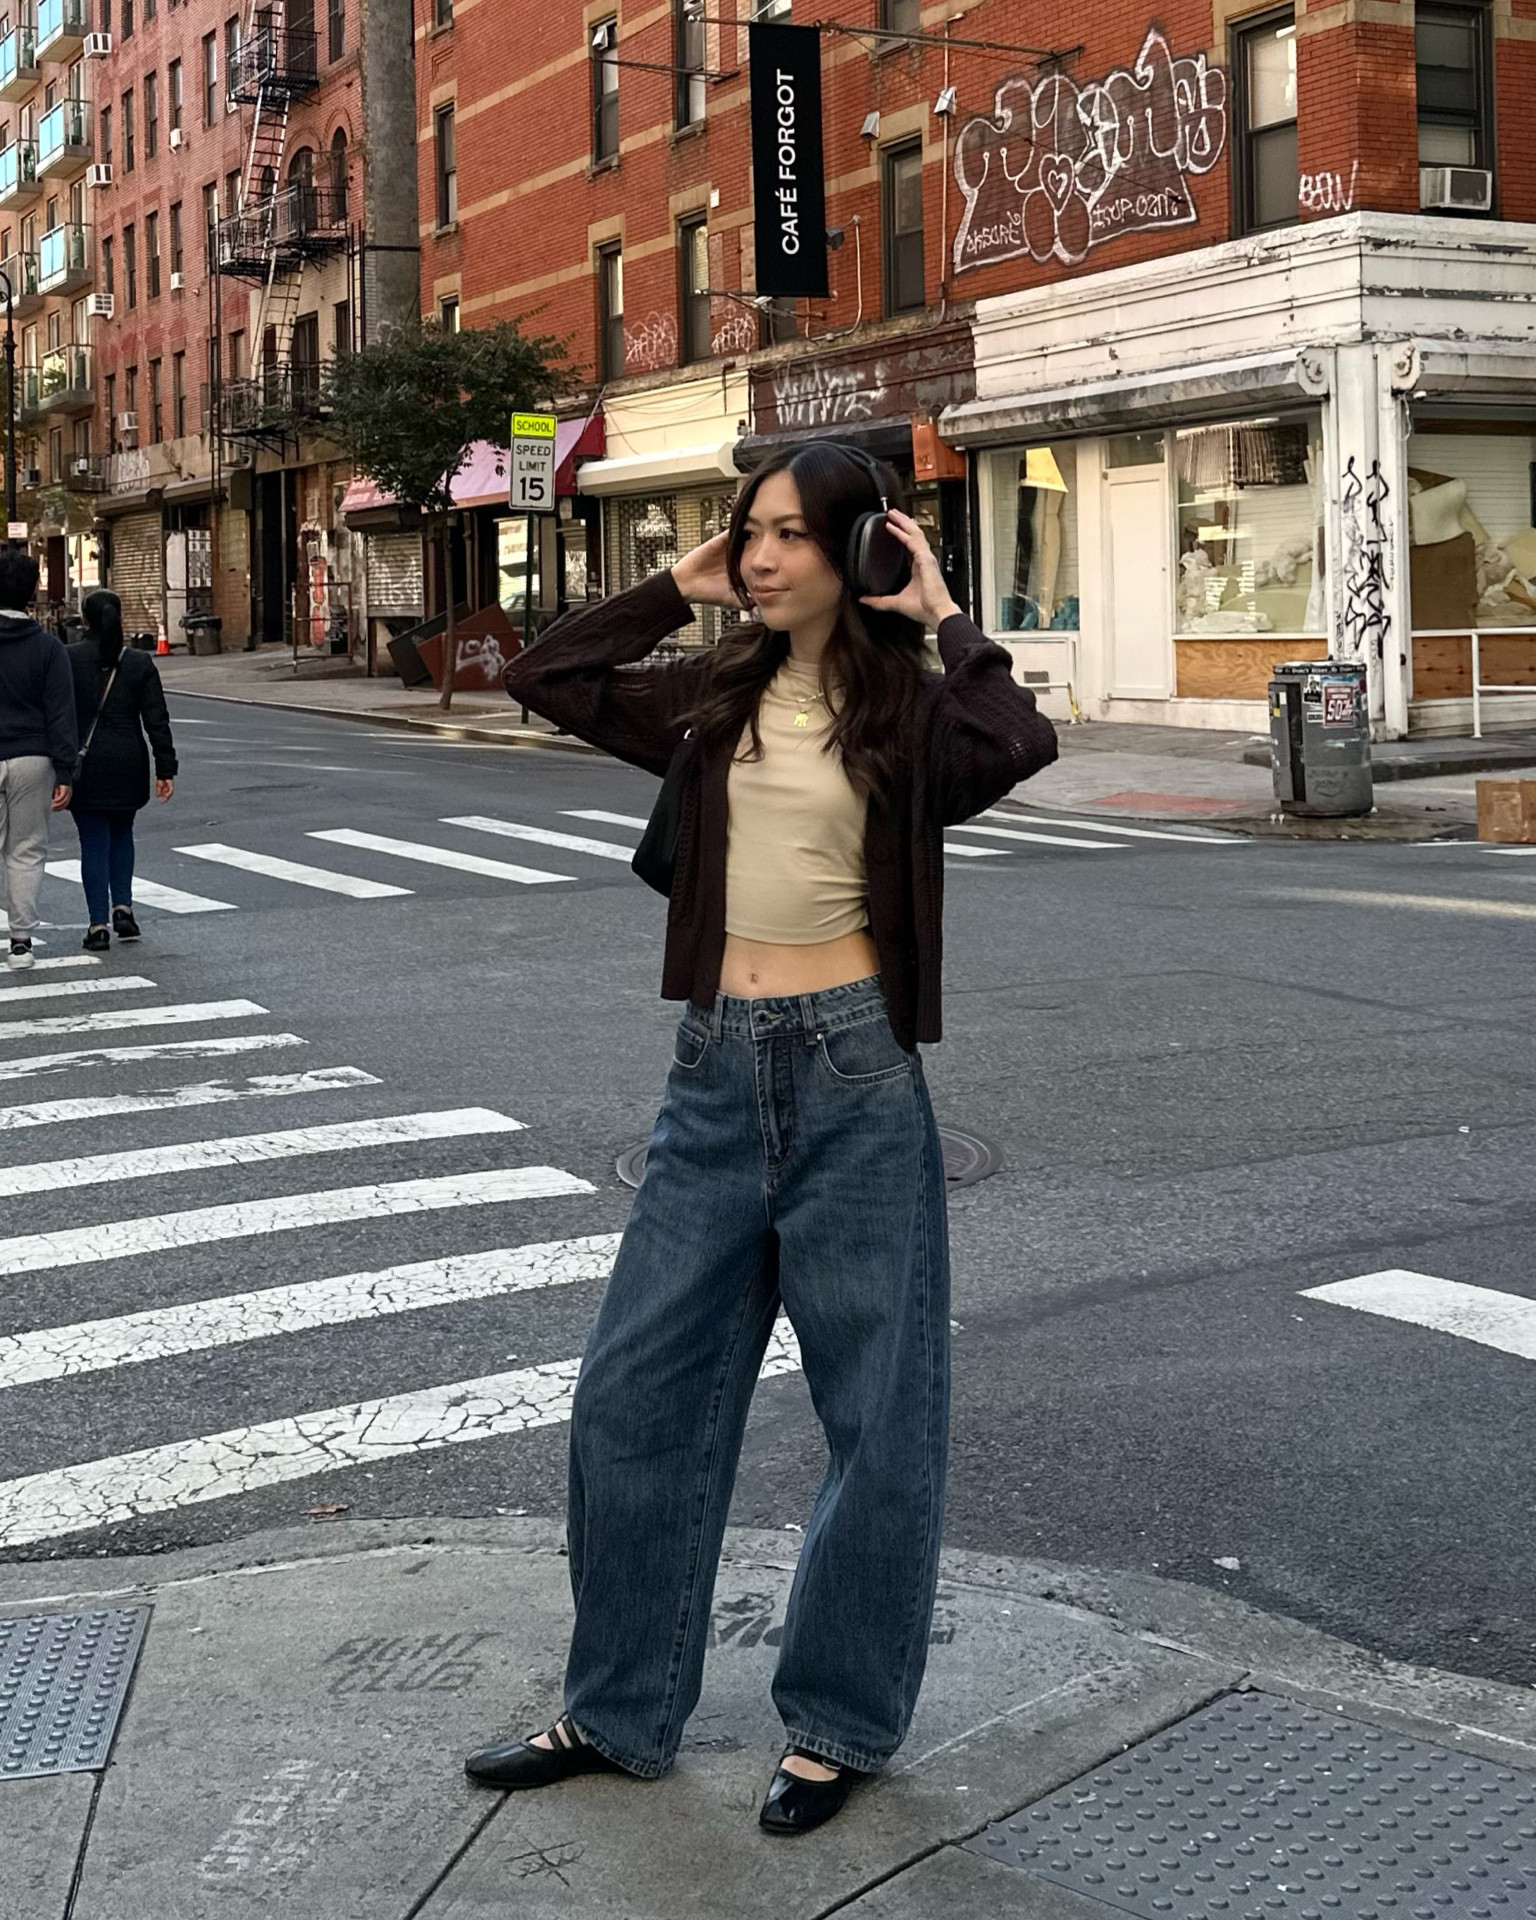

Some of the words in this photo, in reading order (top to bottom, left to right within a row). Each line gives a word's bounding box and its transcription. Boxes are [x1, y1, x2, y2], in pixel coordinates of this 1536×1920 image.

[776, 68, 797, 180] FORGOT
[774, 188, 800, 255] CAFÉ
[516, 420, 552, 433] SCHOOL
[515, 444, 551, 457] SPEED
[519, 461, 546, 472] LIMIT
[520, 476, 545, 502] 15
[1327, 699, 1354, 720] 50%
[320, 1631, 504, 1667] FIGHT
[326, 1662, 484, 1694] CLUB
